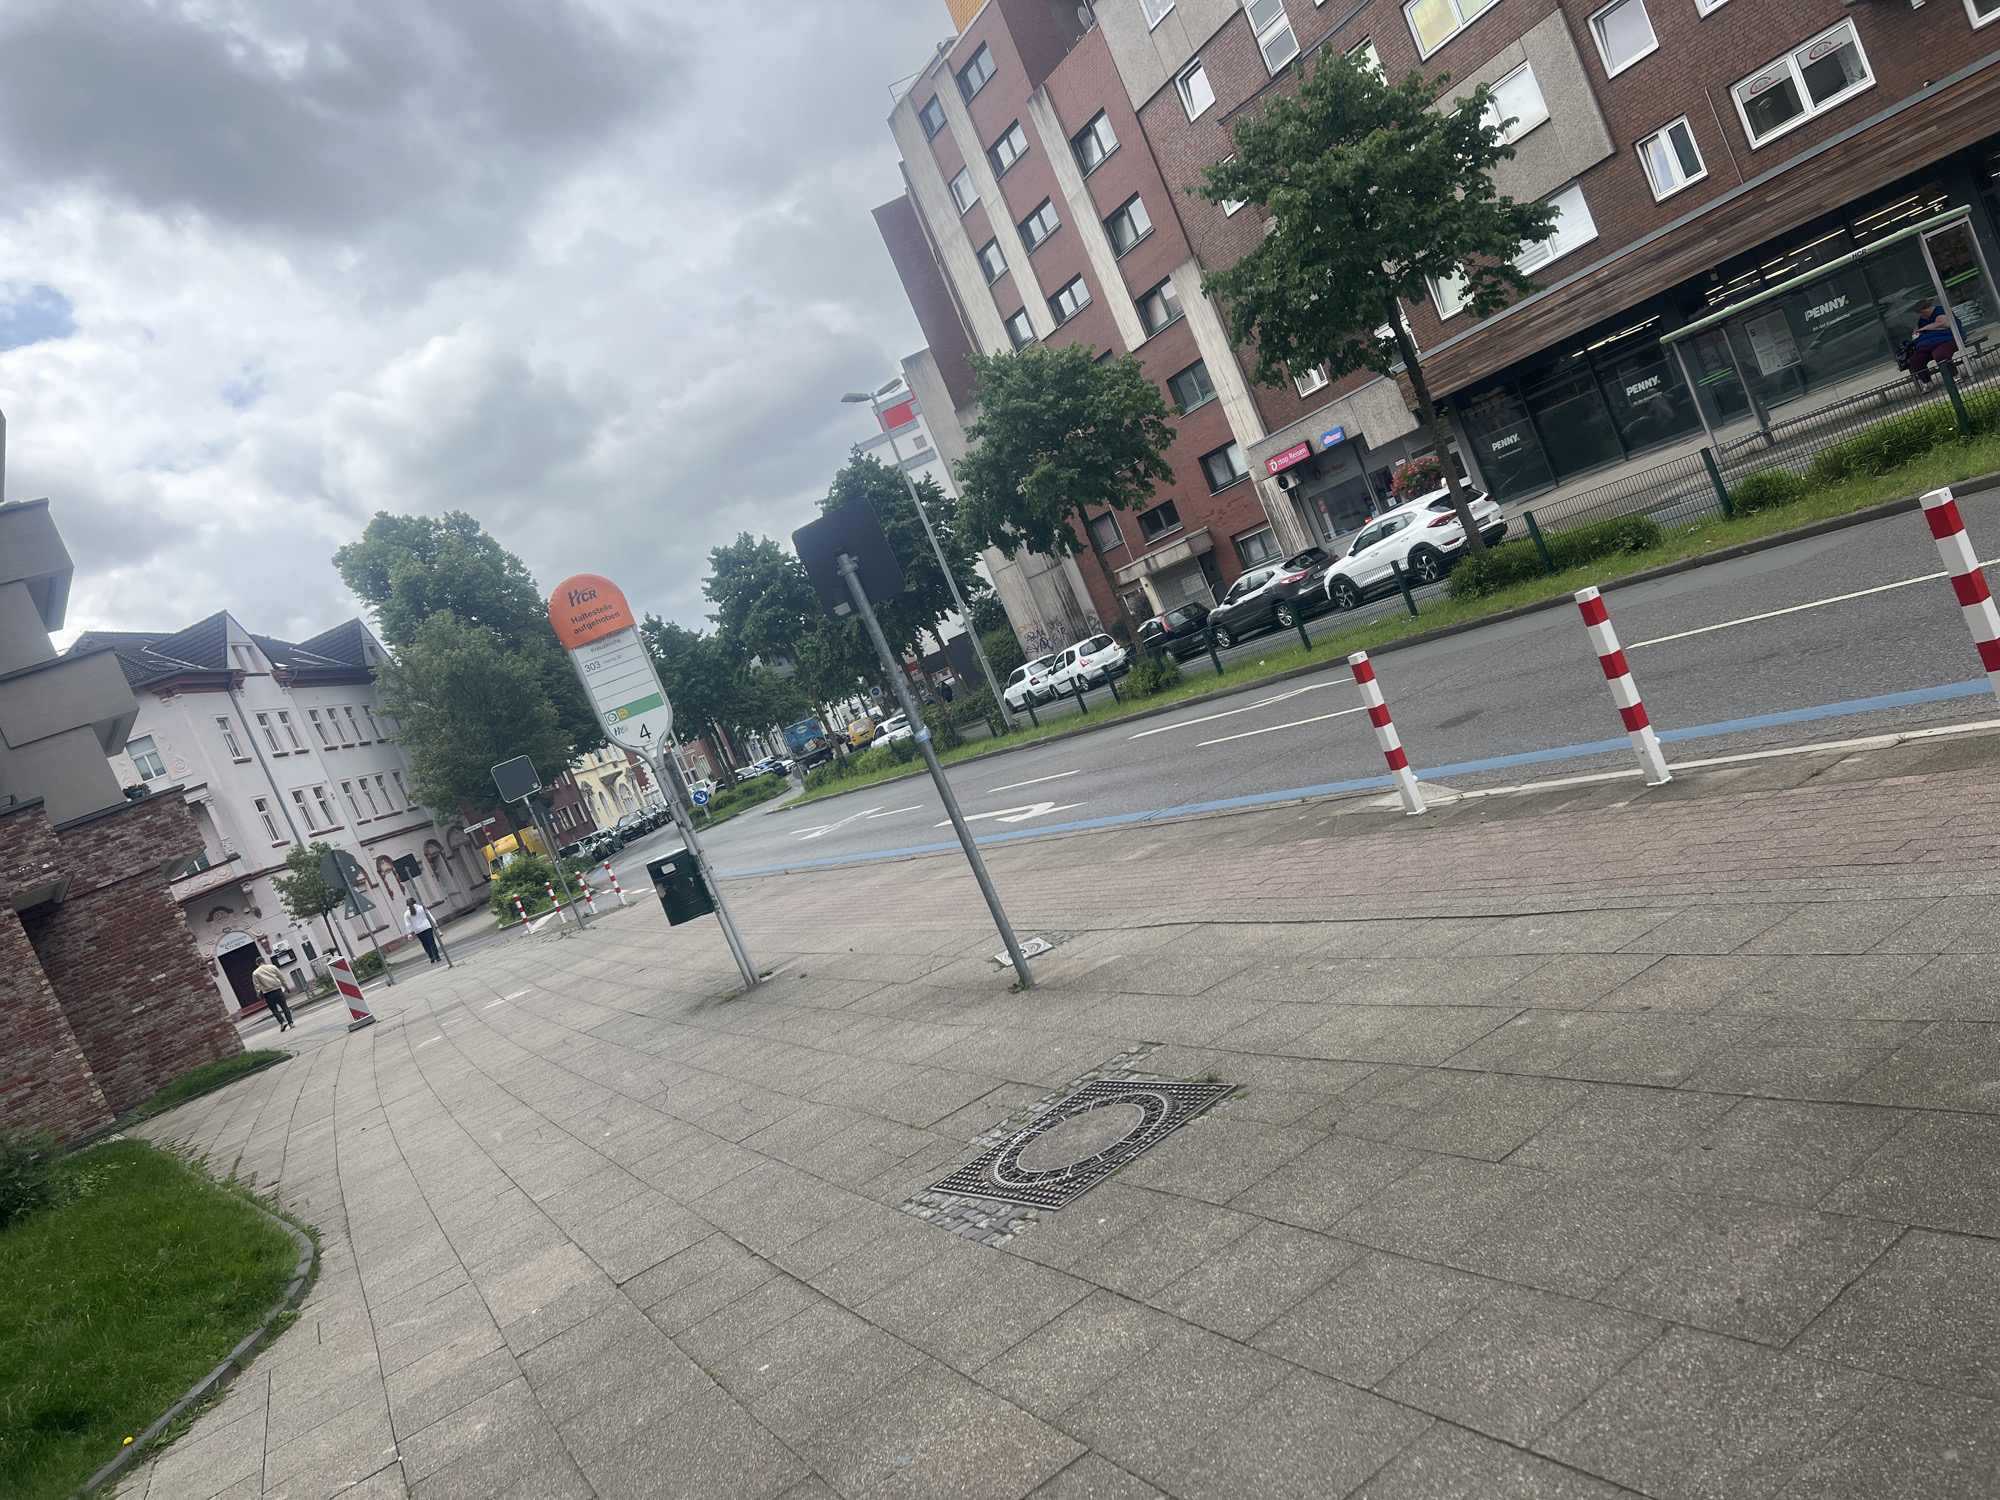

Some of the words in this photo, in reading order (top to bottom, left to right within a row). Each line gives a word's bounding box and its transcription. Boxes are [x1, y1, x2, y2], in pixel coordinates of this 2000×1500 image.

[1851, 248, 1867, 260] HCR
[1288, 447, 1307, 460] Reisen
[568, 586, 597, 607] HCR
[571, 603, 614, 624] Haltestelle
[573, 611, 621, 635] aufgehoben
[590, 639, 622, 653] Kreuzkirche
[584, 660, 602, 673] 303
[640, 723, 652, 739] 4
